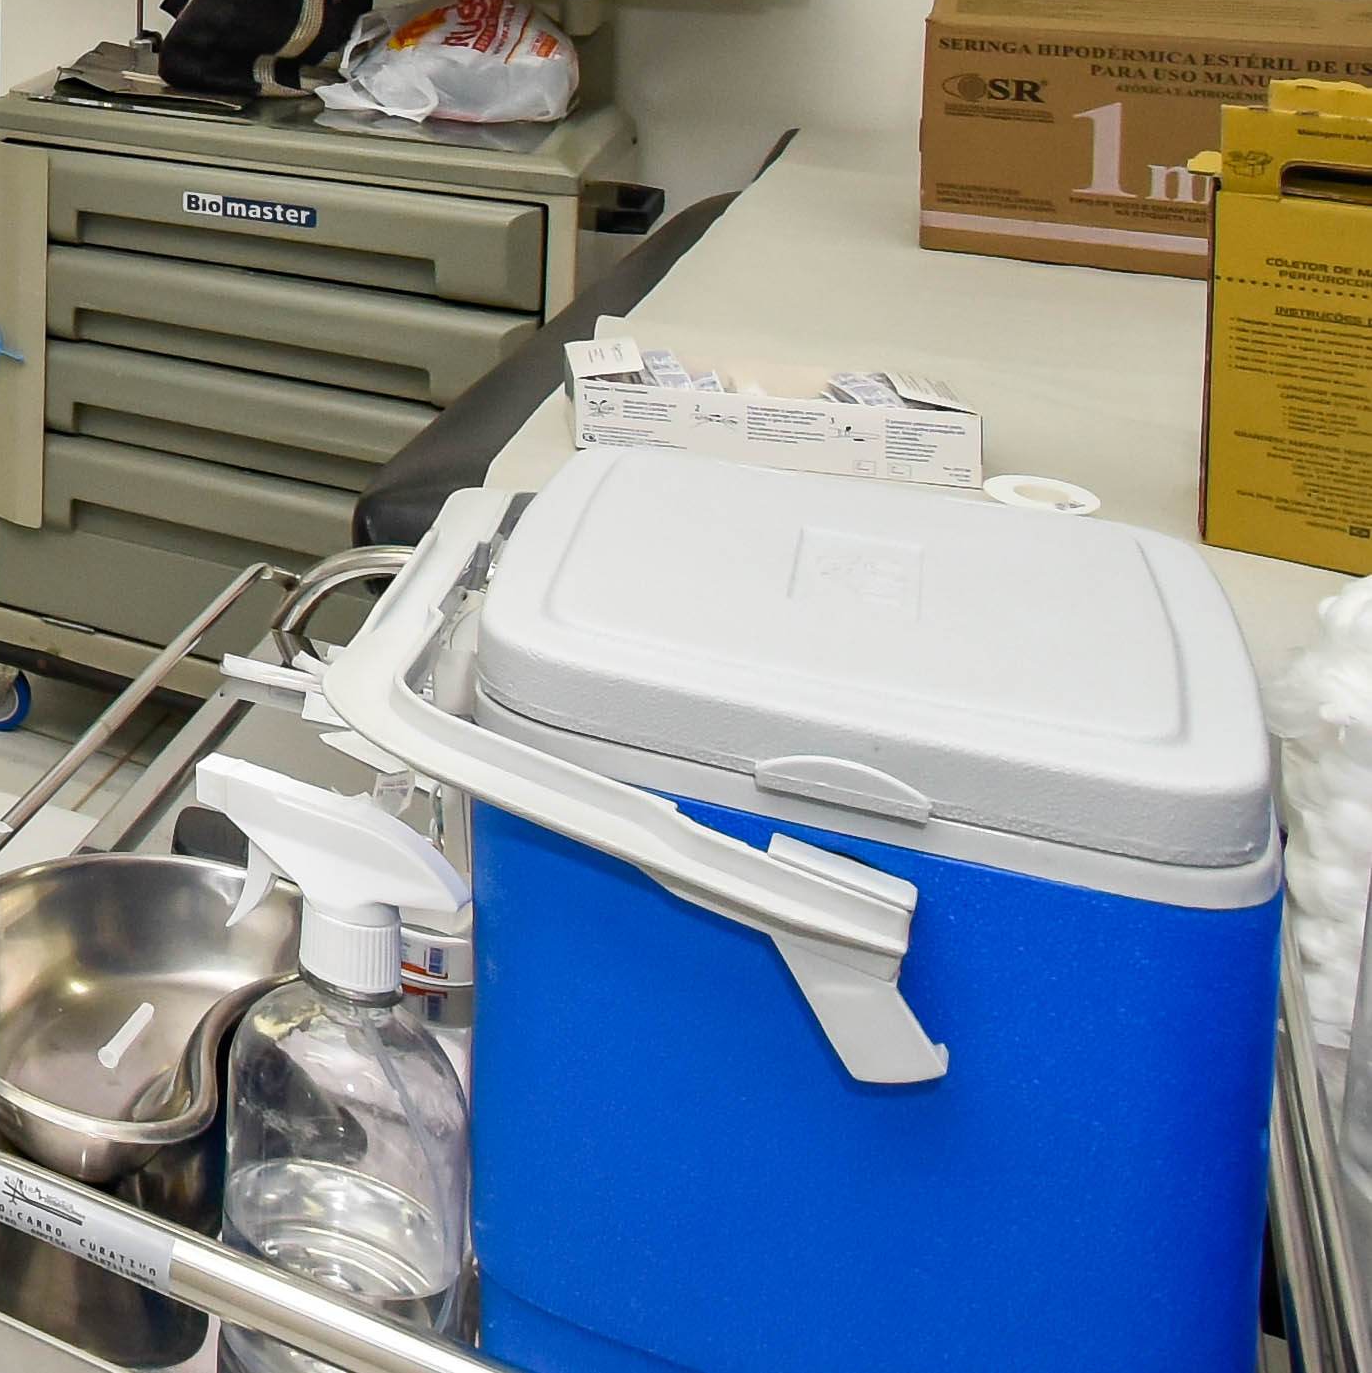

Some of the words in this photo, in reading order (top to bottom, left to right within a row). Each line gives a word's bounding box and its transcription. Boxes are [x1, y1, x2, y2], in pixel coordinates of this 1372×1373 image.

[938, 36, 1032, 56] SERINGA
[1038, 42, 1198, 66] HIPODÉRMICA
[1204, 52, 1300, 73] ESTÉRIL
[1306, 59, 1338, 74] DE
[1089, 64, 1148, 79] PARA
[1154, 67, 1198, 83] USO
[1203, 71, 1273, 88] MANU
